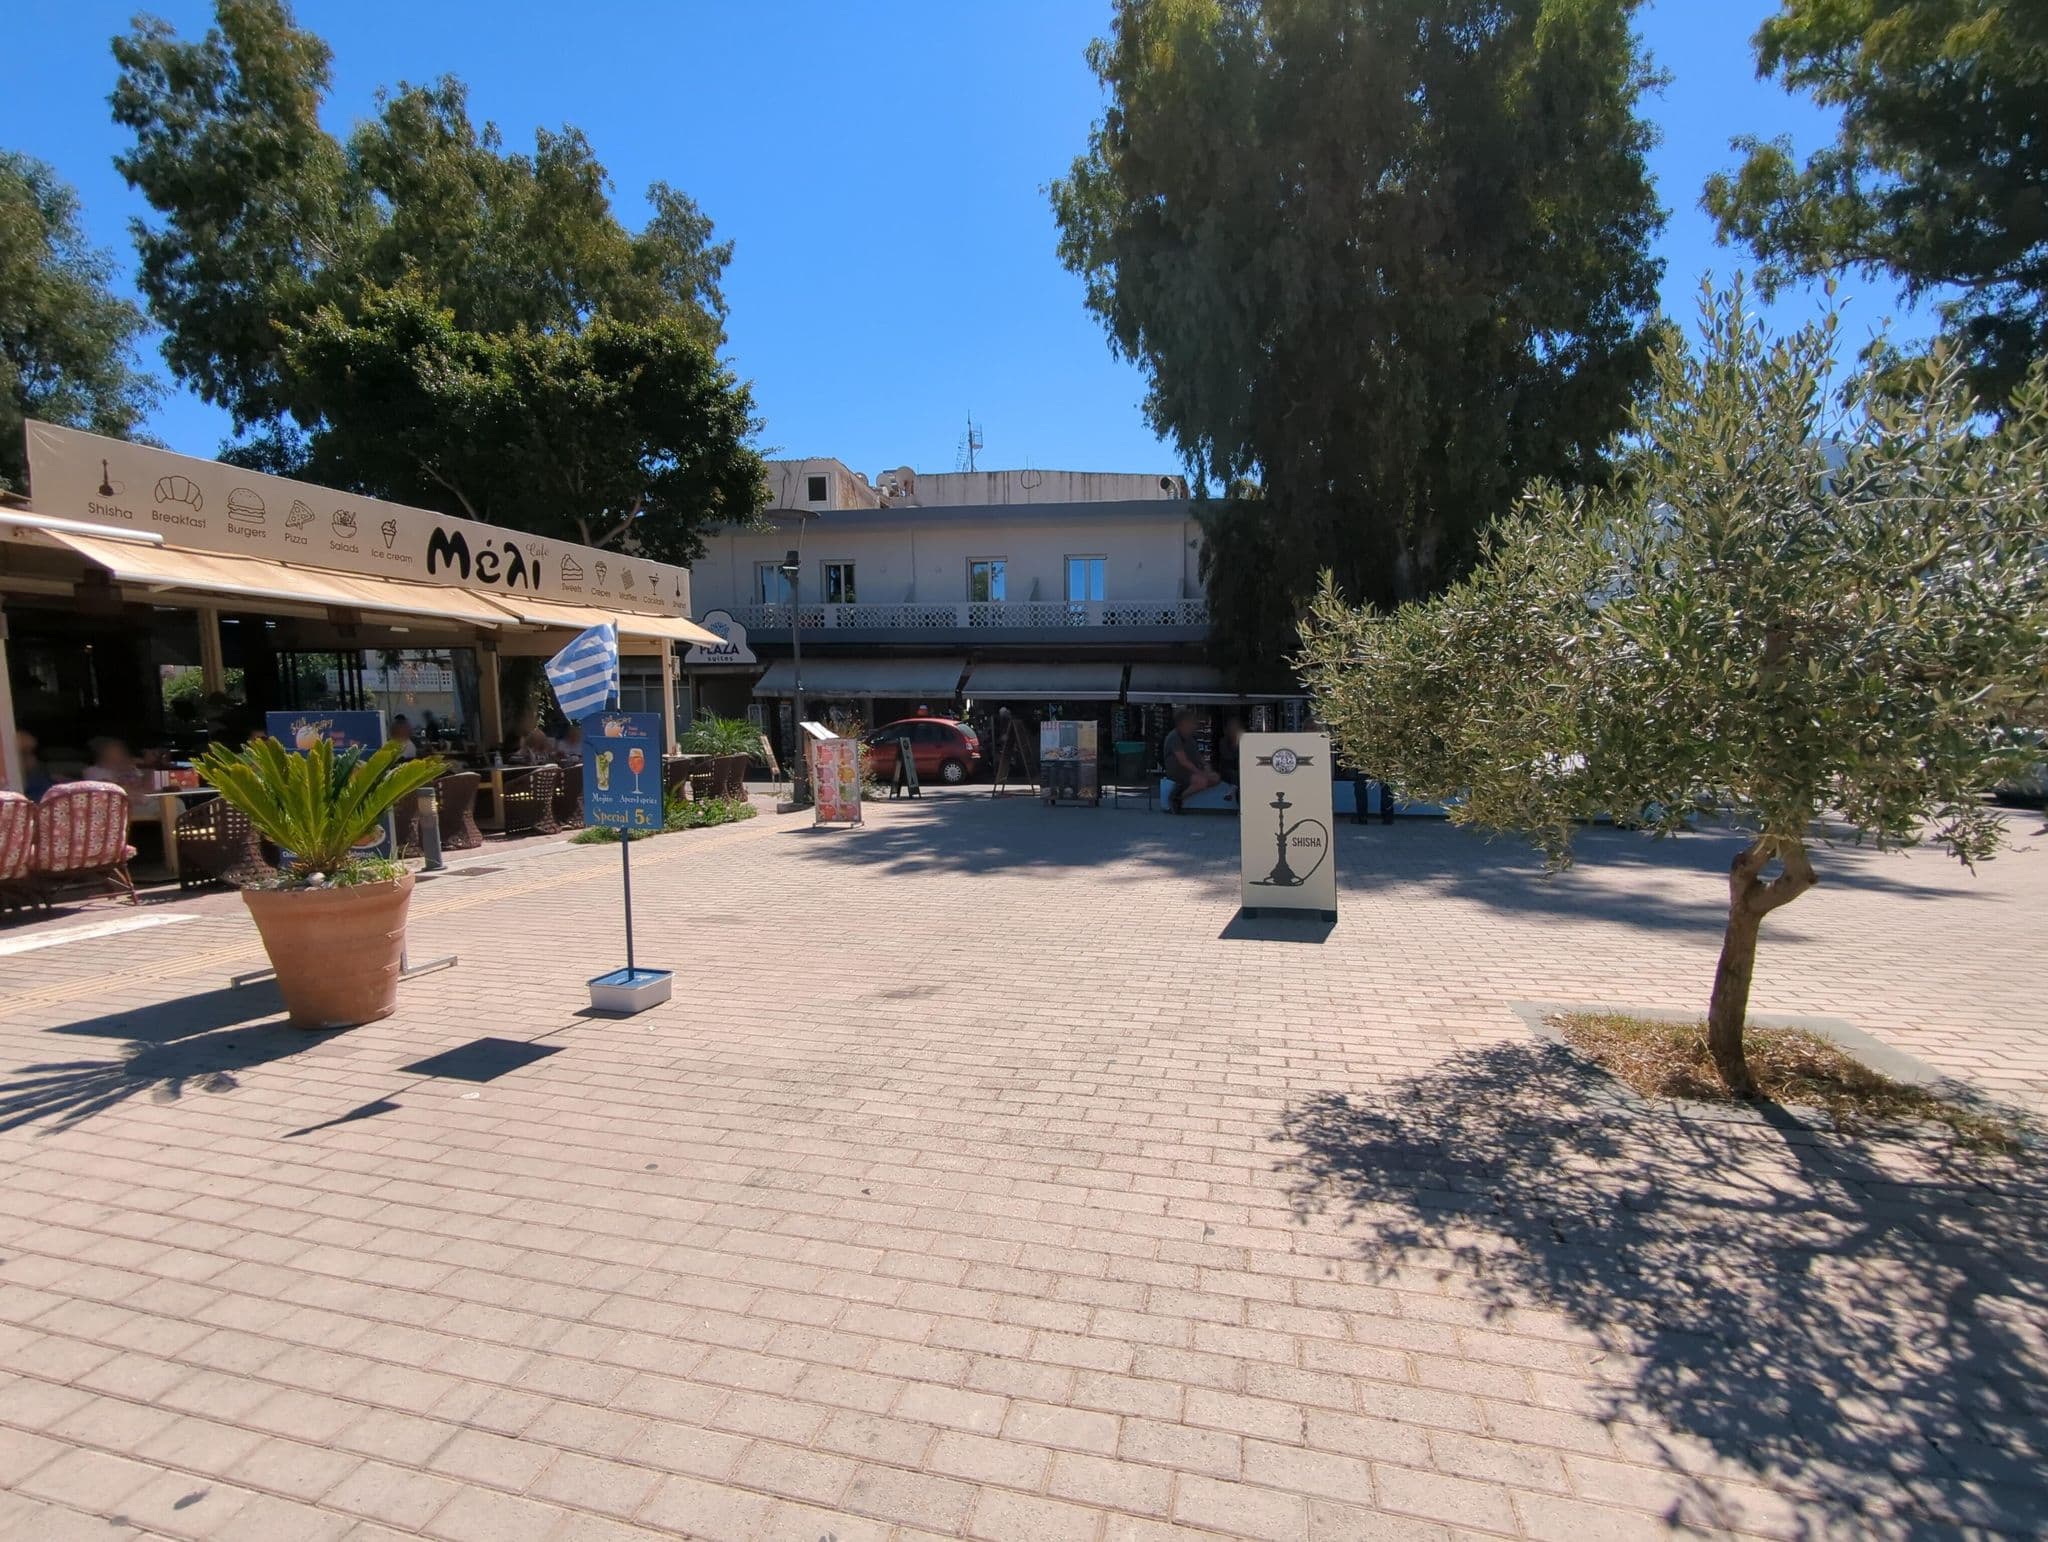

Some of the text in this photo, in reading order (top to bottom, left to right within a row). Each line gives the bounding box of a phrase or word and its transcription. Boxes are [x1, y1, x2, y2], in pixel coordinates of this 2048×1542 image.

[88, 502, 133, 520] Shisha
[152, 511, 206, 528] Breakfast
[227, 523, 267, 539] Burgers
[284, 533, 308, 545] Pizza
[329, 540, 359, 553] Salads
[371, 549, 413, 563] Ice cream
[700, 643, 740, 655] PLAZA
[592, 807, 629, 825] Special
[1292, 837, 1322, 848] SHISHA
